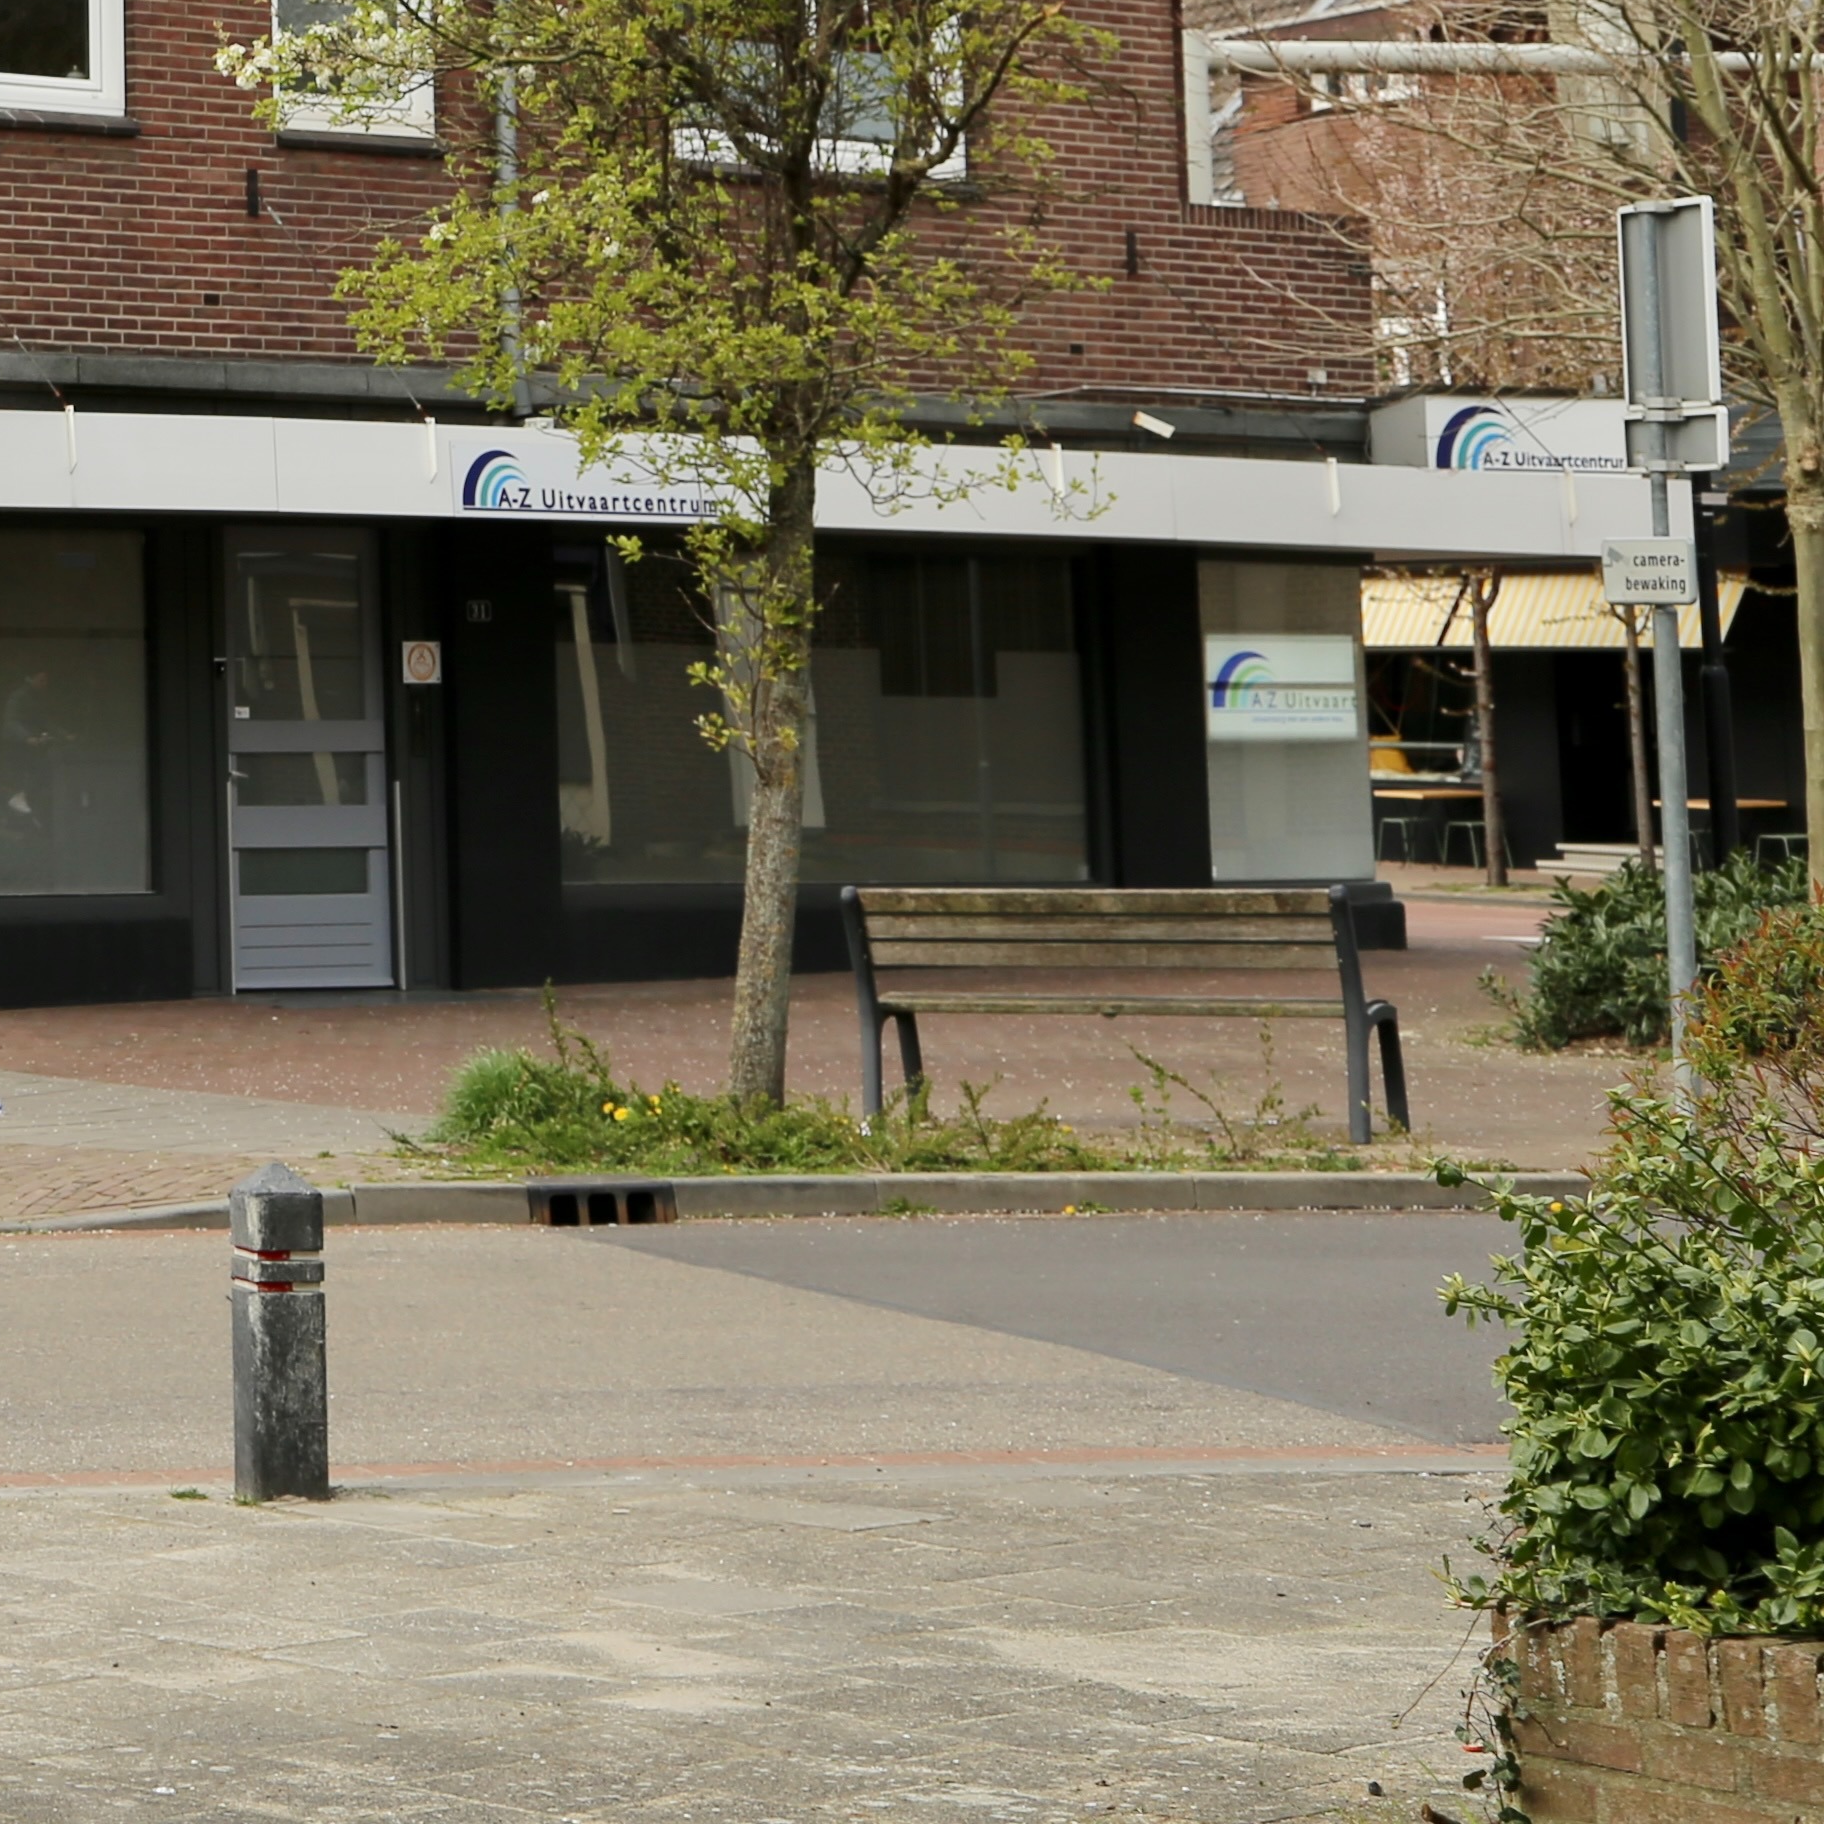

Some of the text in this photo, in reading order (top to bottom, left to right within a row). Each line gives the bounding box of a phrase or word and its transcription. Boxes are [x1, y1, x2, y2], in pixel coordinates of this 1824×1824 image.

[1483, 451, 1510, 467] A-Z
[498, 488, 717, 514] A-Z Uitvaartcentrum
[1633, 555, 1685, 567] camera-
[1625, 576, 1686, 594] bewaking
[1285, 692, 1358, 709] Uitvaart
